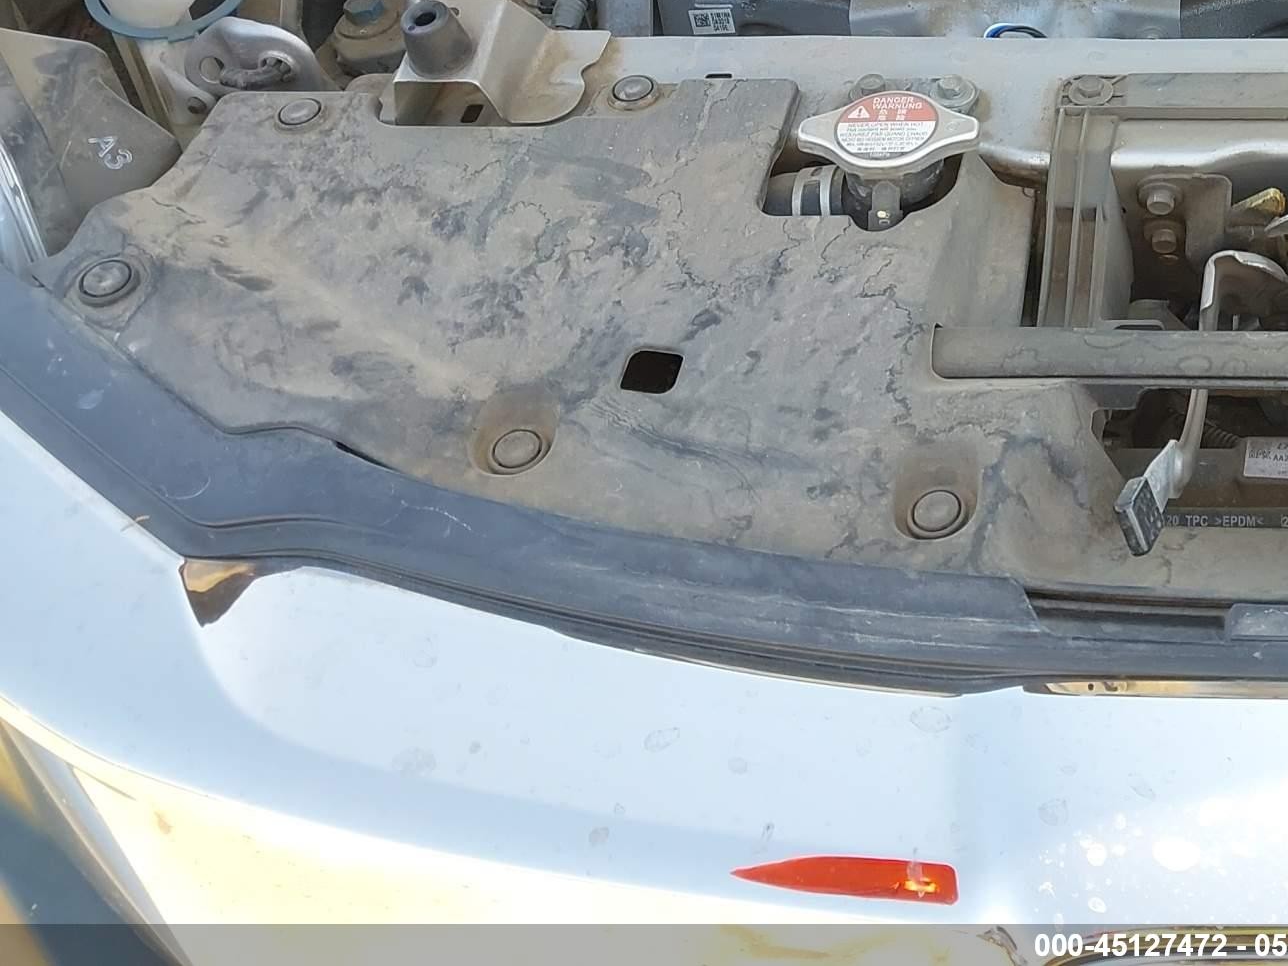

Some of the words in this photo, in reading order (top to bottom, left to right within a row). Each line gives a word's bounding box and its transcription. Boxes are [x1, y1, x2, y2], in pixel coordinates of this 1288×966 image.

[872, 102, 923, 110] WARNUNG
[88, 136, 132, 170] A3
[1185, 514, 1208, 526] TPC
[1215, 514, 1264, 526] >EPDM<
